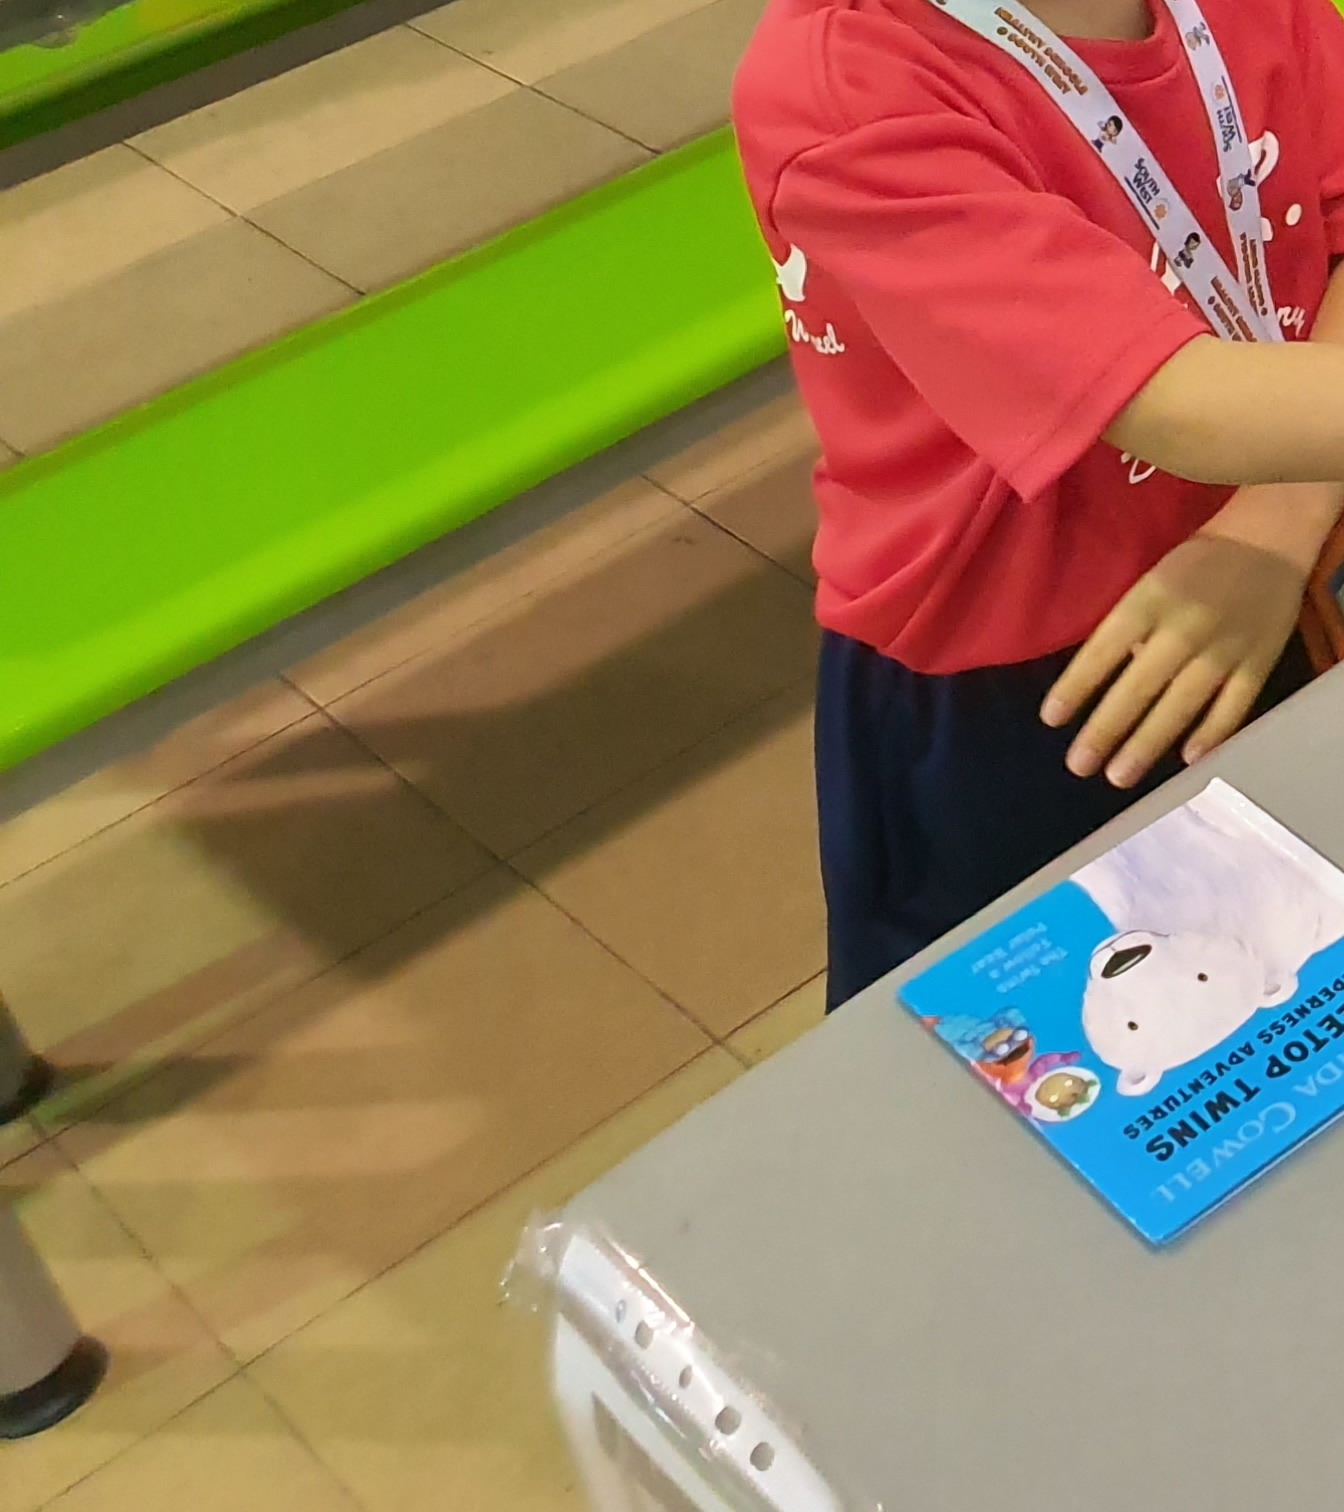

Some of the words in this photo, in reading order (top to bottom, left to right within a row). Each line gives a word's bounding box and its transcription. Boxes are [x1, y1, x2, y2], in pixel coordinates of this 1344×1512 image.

[1132, 172, 1153, 204] WEST
[1134, 157, 1161, 197] SOUTH
[1122, 1041, 1257, 1140] ADVENTURES
[1145, 1077, 1262, 1163] TWINS
[1152, 1100, 1298, 1204] COWELL
